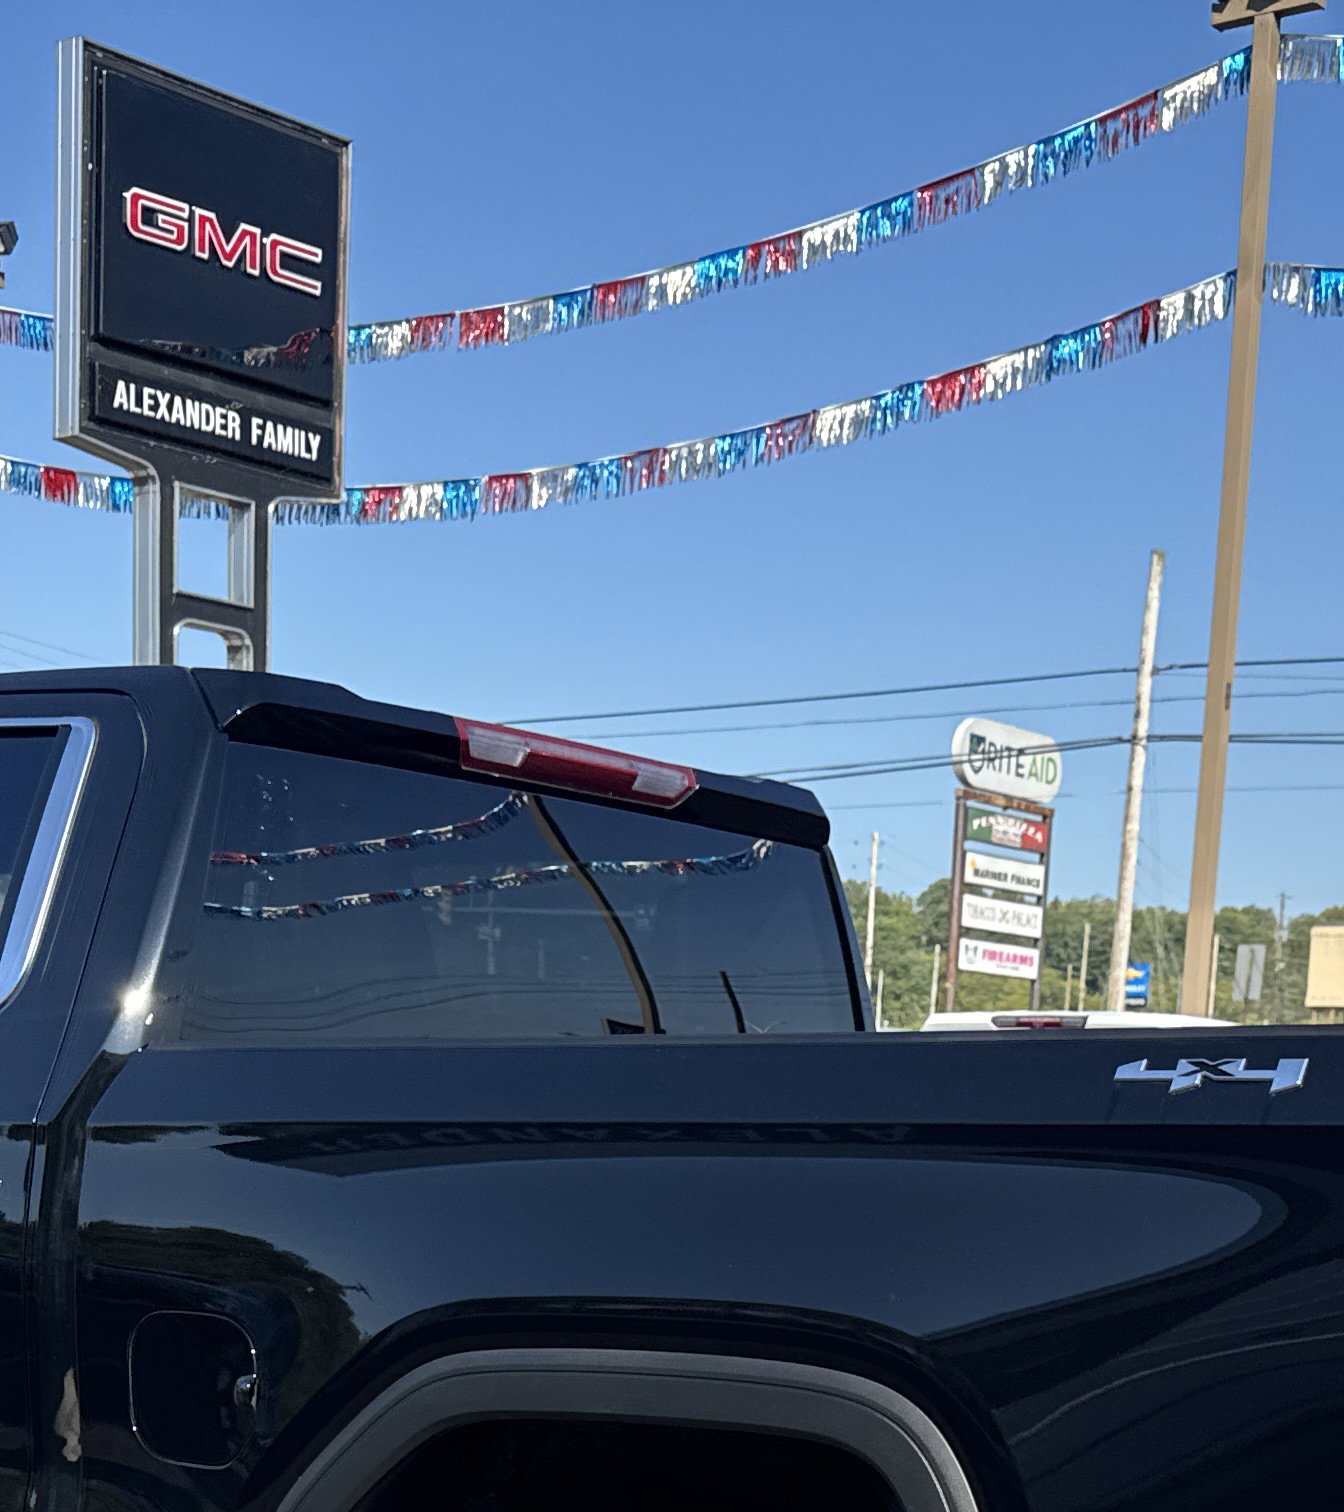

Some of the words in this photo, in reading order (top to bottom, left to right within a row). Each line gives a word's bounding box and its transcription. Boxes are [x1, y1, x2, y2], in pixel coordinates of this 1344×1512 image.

[122, 187, 322, 297] GMC
[112, 380, 241, 441] ALEXANDER
[251, 416, 321, 462] FAMILY
[987, 741, 1025, 778] RITE
[1027, 753, 1058, 785] AID
